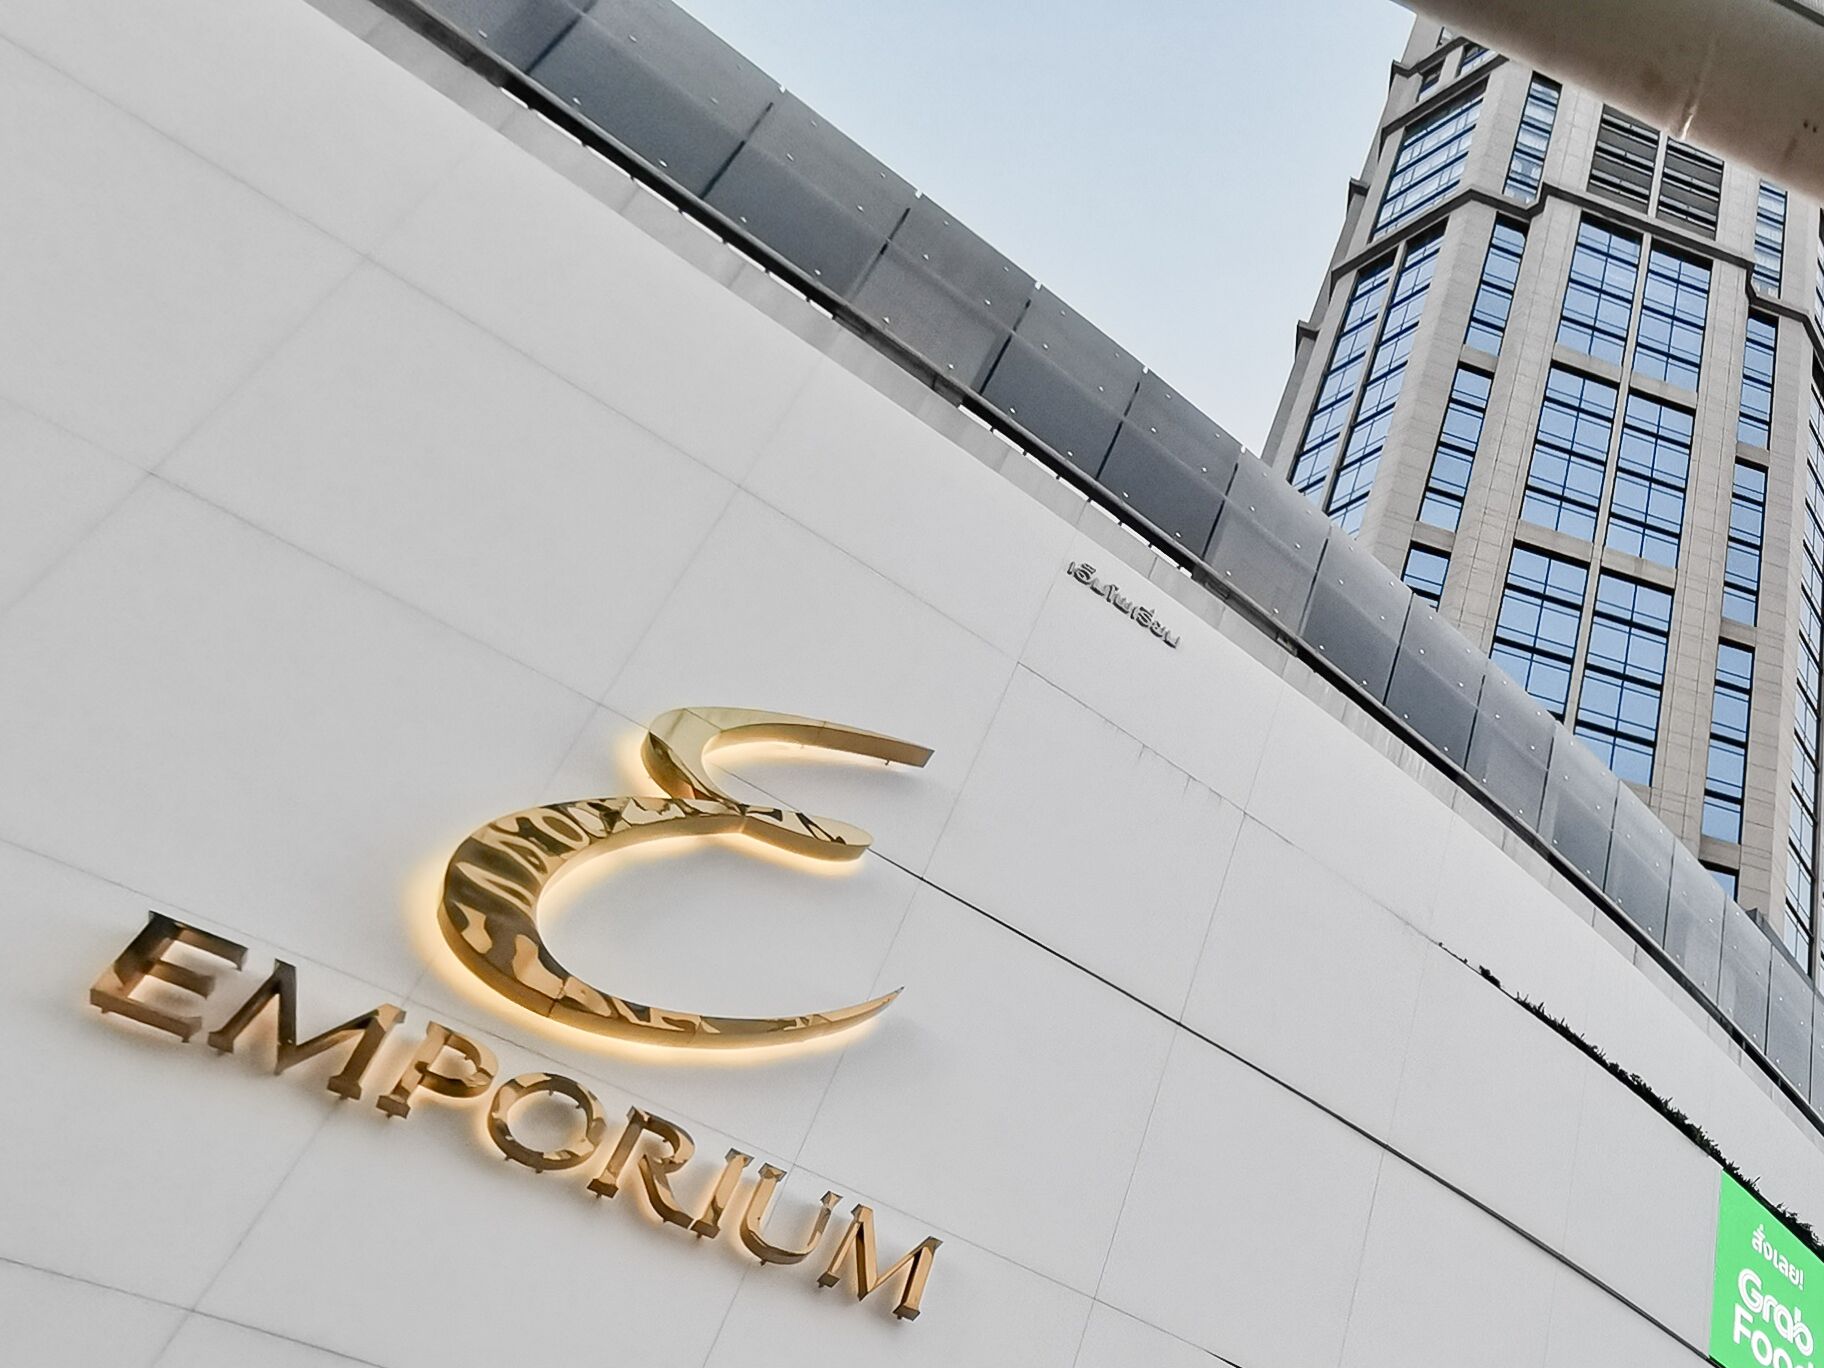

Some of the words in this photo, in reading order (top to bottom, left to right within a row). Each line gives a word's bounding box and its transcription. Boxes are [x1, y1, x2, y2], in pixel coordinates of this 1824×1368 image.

[88, 910, 944, 1323] EMPORIUM
[1751, 1223, 1805, 1290] สั่งเลย!
[1737, 1268, 1814, 1357] Grab
